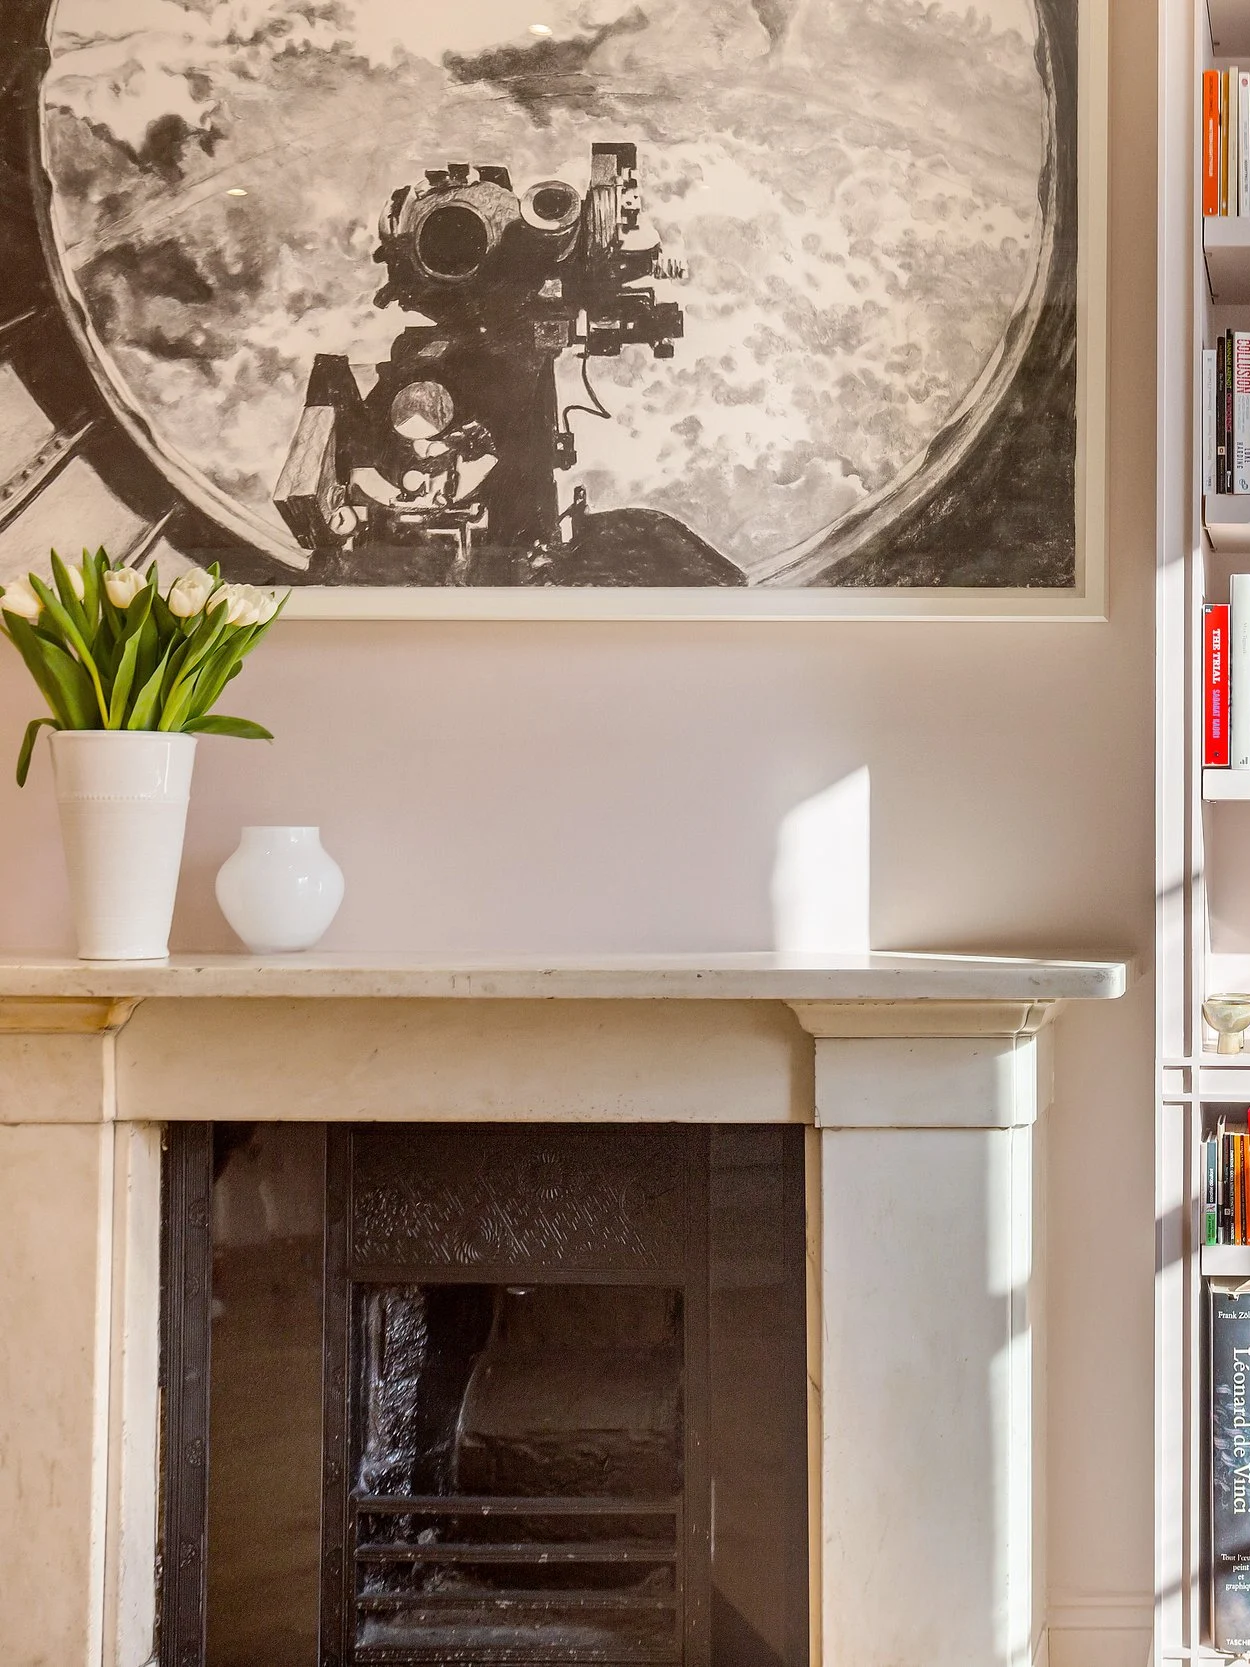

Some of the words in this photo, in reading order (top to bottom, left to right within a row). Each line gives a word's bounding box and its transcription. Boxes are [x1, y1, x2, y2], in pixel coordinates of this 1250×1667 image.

[1212, 628, 1221, 651] THE
[1212, 652, 1221, 684] TRIAL
[1217, 1311, 1237, 1319] Frank
[1221, 1553, 1236, 1561] Tout
[1232, 1563, 1250, 1572] peint
